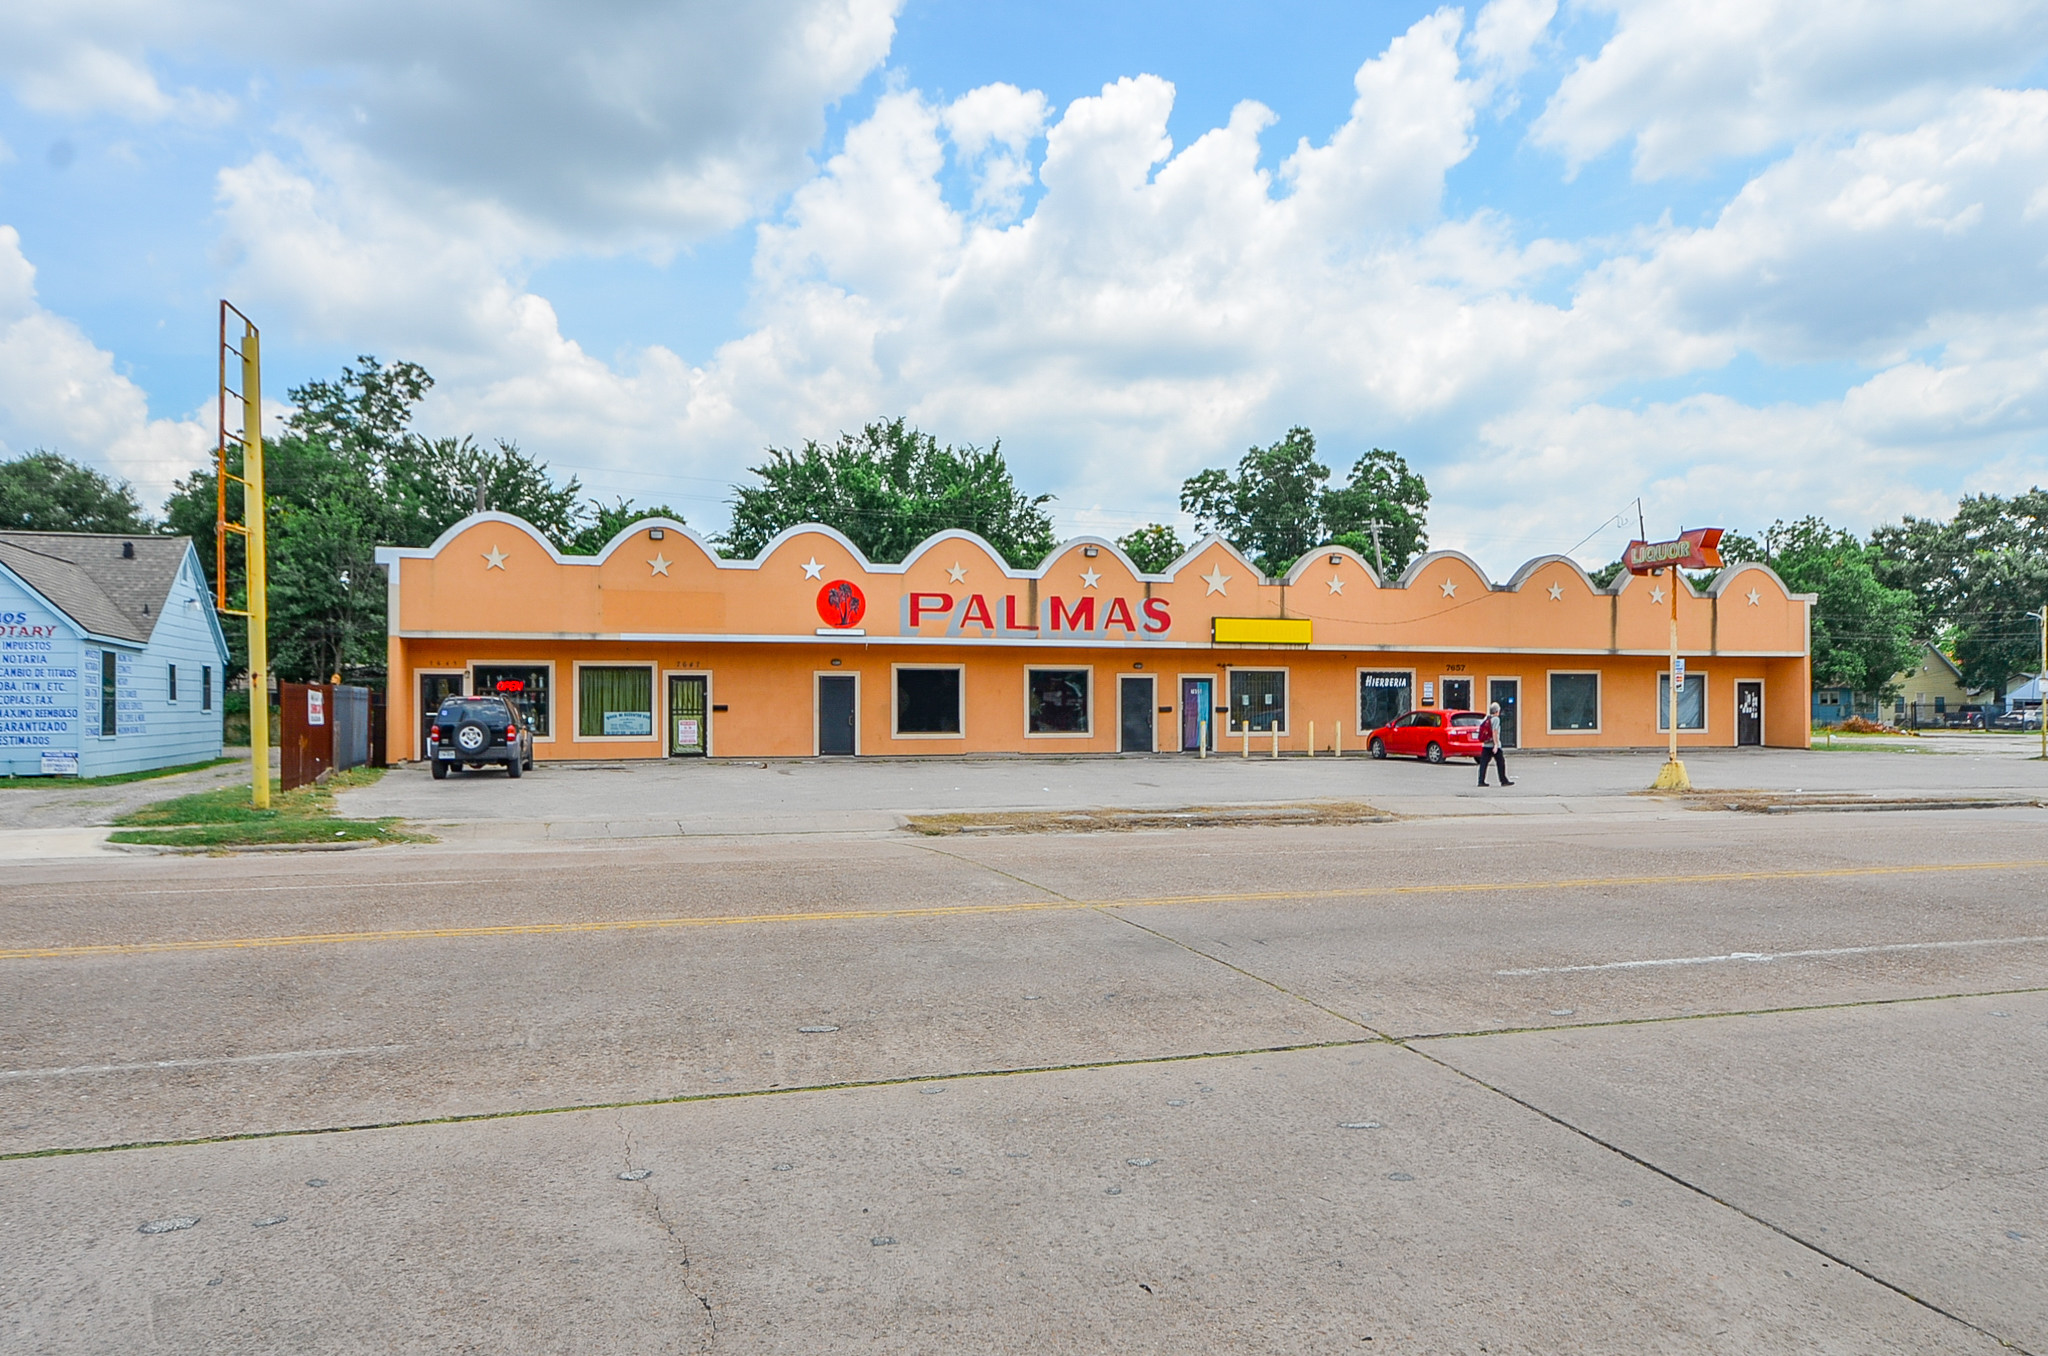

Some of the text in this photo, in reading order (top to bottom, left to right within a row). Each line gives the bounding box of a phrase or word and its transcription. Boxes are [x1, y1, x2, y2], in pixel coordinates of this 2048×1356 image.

[1631, 541, 1691, 564] LIQUOR
[908, 592, 1172, 634] PALMAS
[3, 641, 51, 650] IMPUESTOS
[3, 655, 47, 664] NOTARIA
[35, 669, 44, 677] DE
[47, 669, 77, 678] TITULOS
[496, 680, 524, 692] OPEN
[36, 696, 53, 704] FAX
[35, 709, 78, 718] REEMBOLSO
